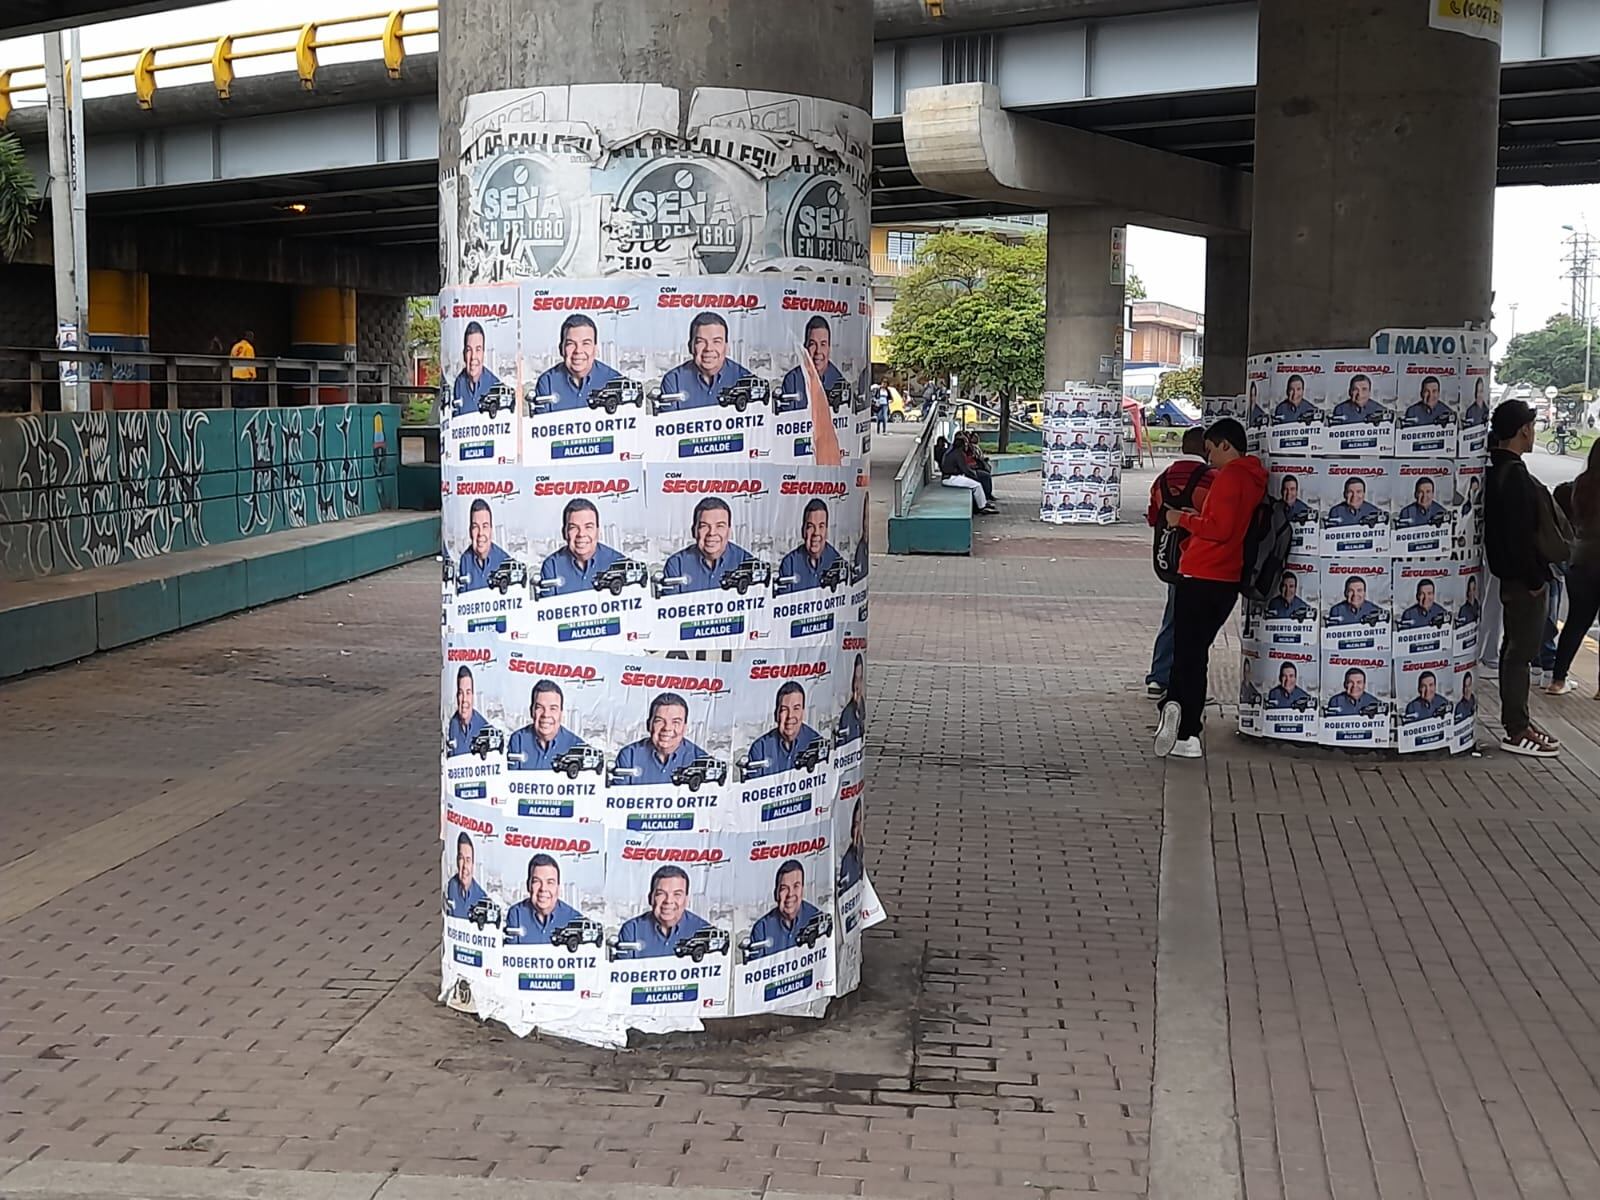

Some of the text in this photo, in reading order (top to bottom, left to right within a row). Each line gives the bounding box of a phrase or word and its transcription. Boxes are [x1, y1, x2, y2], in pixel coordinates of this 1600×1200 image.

[484, 187, 563, 220] SENA
[633, 191, 735, 224] SENA
[483, 221, 498, 239] EN
[632, 225, 653, 240] EN
[798, 238, 814, 257] EN
[533, 296, 630, 311] SEGURIDAD
[657, 294, 759, 308] SEGURIDAD
[782, 296, 848, 313] SEGURIDAD
[453, 304, 507, 318] SEGURIDAD
[1376, 333, 1456, 354] 1 MAYO
[452, 425, 480, 439] ROBERTO
[482, 423, 510, 436] ORTIZ
[532, 417, 636, 438] ROBERTO ORTIZ
[656, 415, 764, 437] ROBERTO ORTIZ
[564, 445, 600, 456] ALCALDE
[693, 442, 731, 454] ALCALDE
[457, 481, 513, 495] SEGURIDAD
[534, 479, 630, 496] SEGURIDAD
[662, 480, 761, 493] SEGURIDAD
[780, 482, 847, 495] SEGURIDAD
[458, 598, 522, 616] ROBERTO ORTIZ
[537, 597, 642, 621] ROBERTO ORTIZ
[658, 597, 765, 619] ROBERTO ORTIZ
[773, 595, 846, 618] ROBERTO ORTIZ
[571, 626, 607, 638] ALCALDE
[695, 625, 731, 637] ALCALDE
[801, 622, 828, 634] ALCALDE
[508, 659, 596, 679] SEGURIDAD
[750, 661, 827, 679] SEGURIDAD
[621, 672, 723, 691] SEGURIDAD
[475, 764, 501, 777] ORTIZ
[558, 784, 596, 796] ORTIZ
[742, 782, 797, 803] ROBERTO
[799, 773, 827, 791] ORTIZ
[606, 795, 718, 809] ROBERTO ORTIZ
[773, 803, 802, 817] ALCALDE
[529, 806, 561, 816] ALCALDE
[447, 809, 493, 835] SEGURIDAD
[641, 821, 679, 829] ALCALDE
[504, 833, 591, 852] SEGURIDAD
[750, 837, 826, 861] SEGURIDAD
[622, 847, 723, 862] SEGURIDAD
[472, 932, 497, 949] ORTIZ
[503, 956, 596, 969] ROBERTO ORTIZ
[744, 960, 798, 984] ROBERTO
[801, 947, 827, 967] ORTIZ
[610, 965, 721, 983] ROBERTO ORTIZ
[530, 980, 561, 989] ALCALDE
[776, 981, 804, 996] ALCALDE
[646, 992, 684, 1002] ALCALDE
